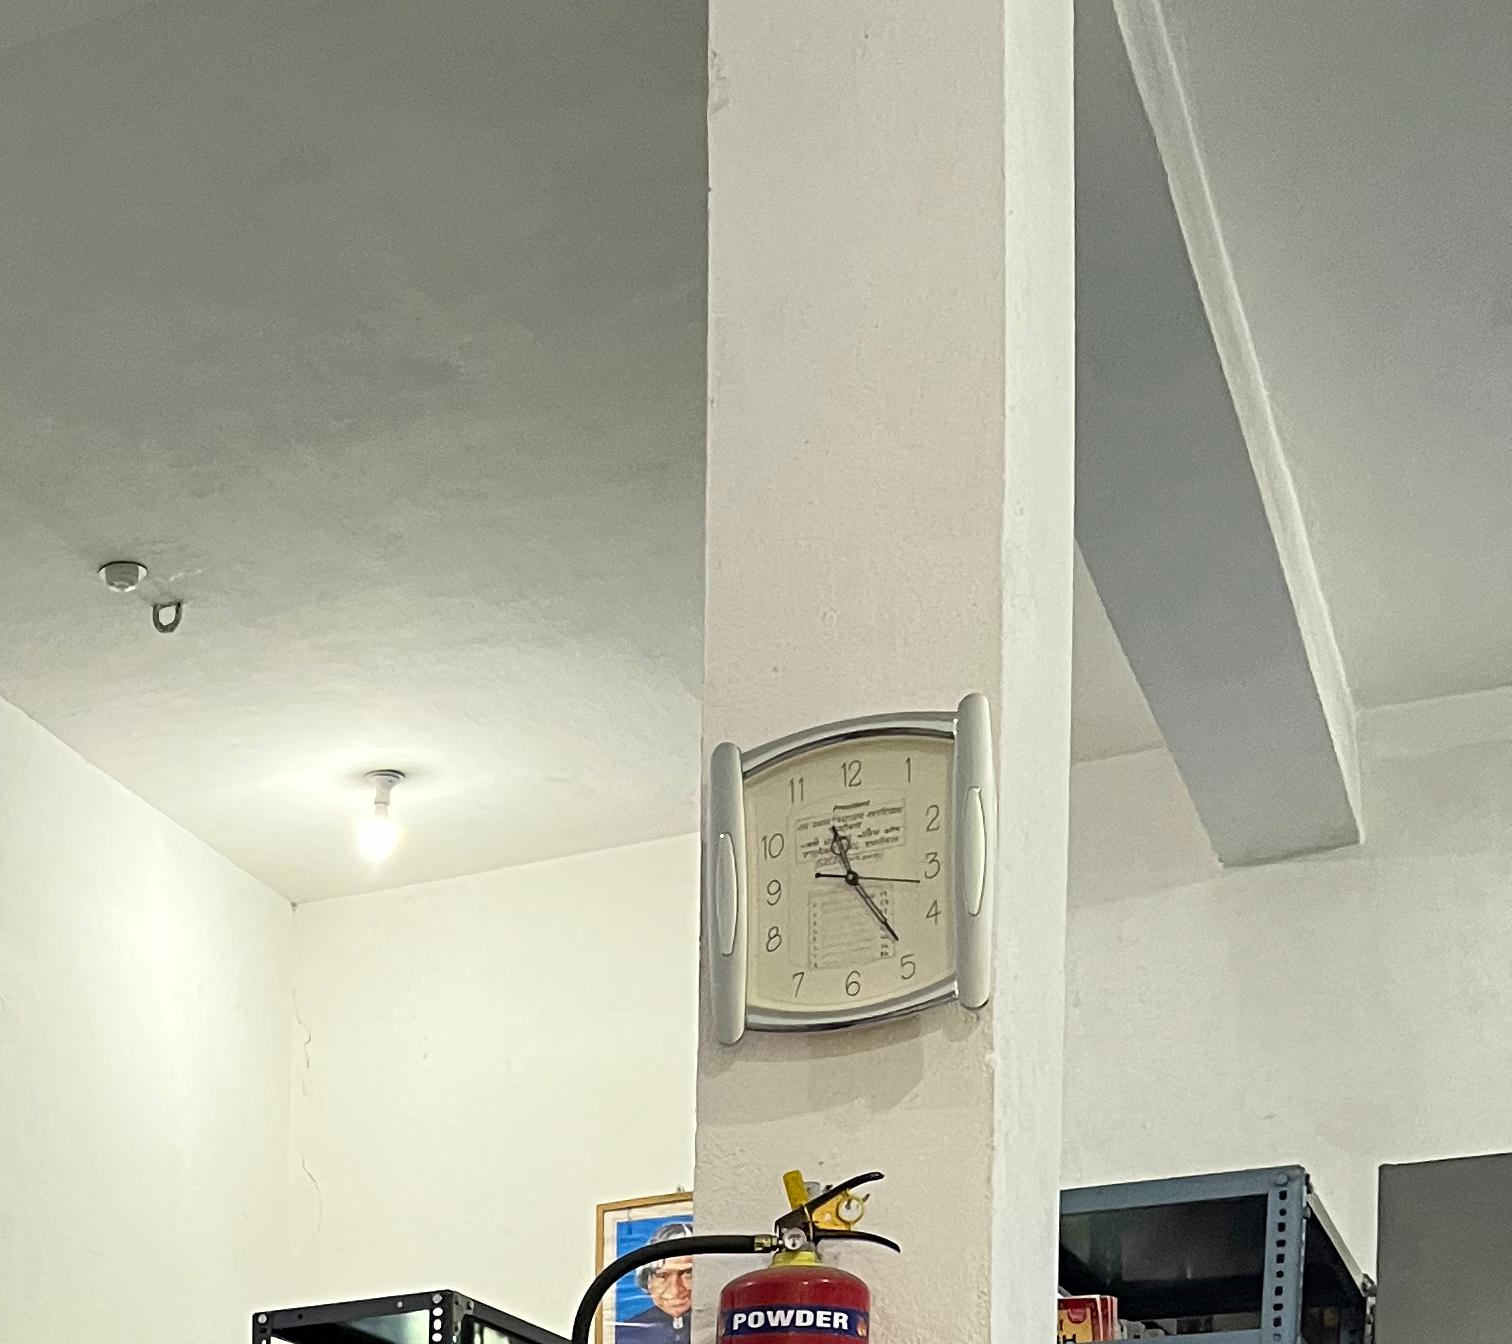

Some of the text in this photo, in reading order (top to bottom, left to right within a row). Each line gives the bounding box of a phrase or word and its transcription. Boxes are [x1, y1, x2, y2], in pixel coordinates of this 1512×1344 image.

[841, 760, 862, 788] 12
[906, 758, 911, 783] 1
[789, 778, 805, 804] 11
[926, 805, 940, 832] 2
[762, 833, 785, 860] 10
[924, 852, 941, 878] 3
[766, 879, 782, 906] 9
[926, 900, 941, 926] 4
[766, 926, 782, 952] 8
[901, 954, 916, 979] 5
[792, 972, 806, 998] 7
[732, 1309, 849, 1331] POWDER
